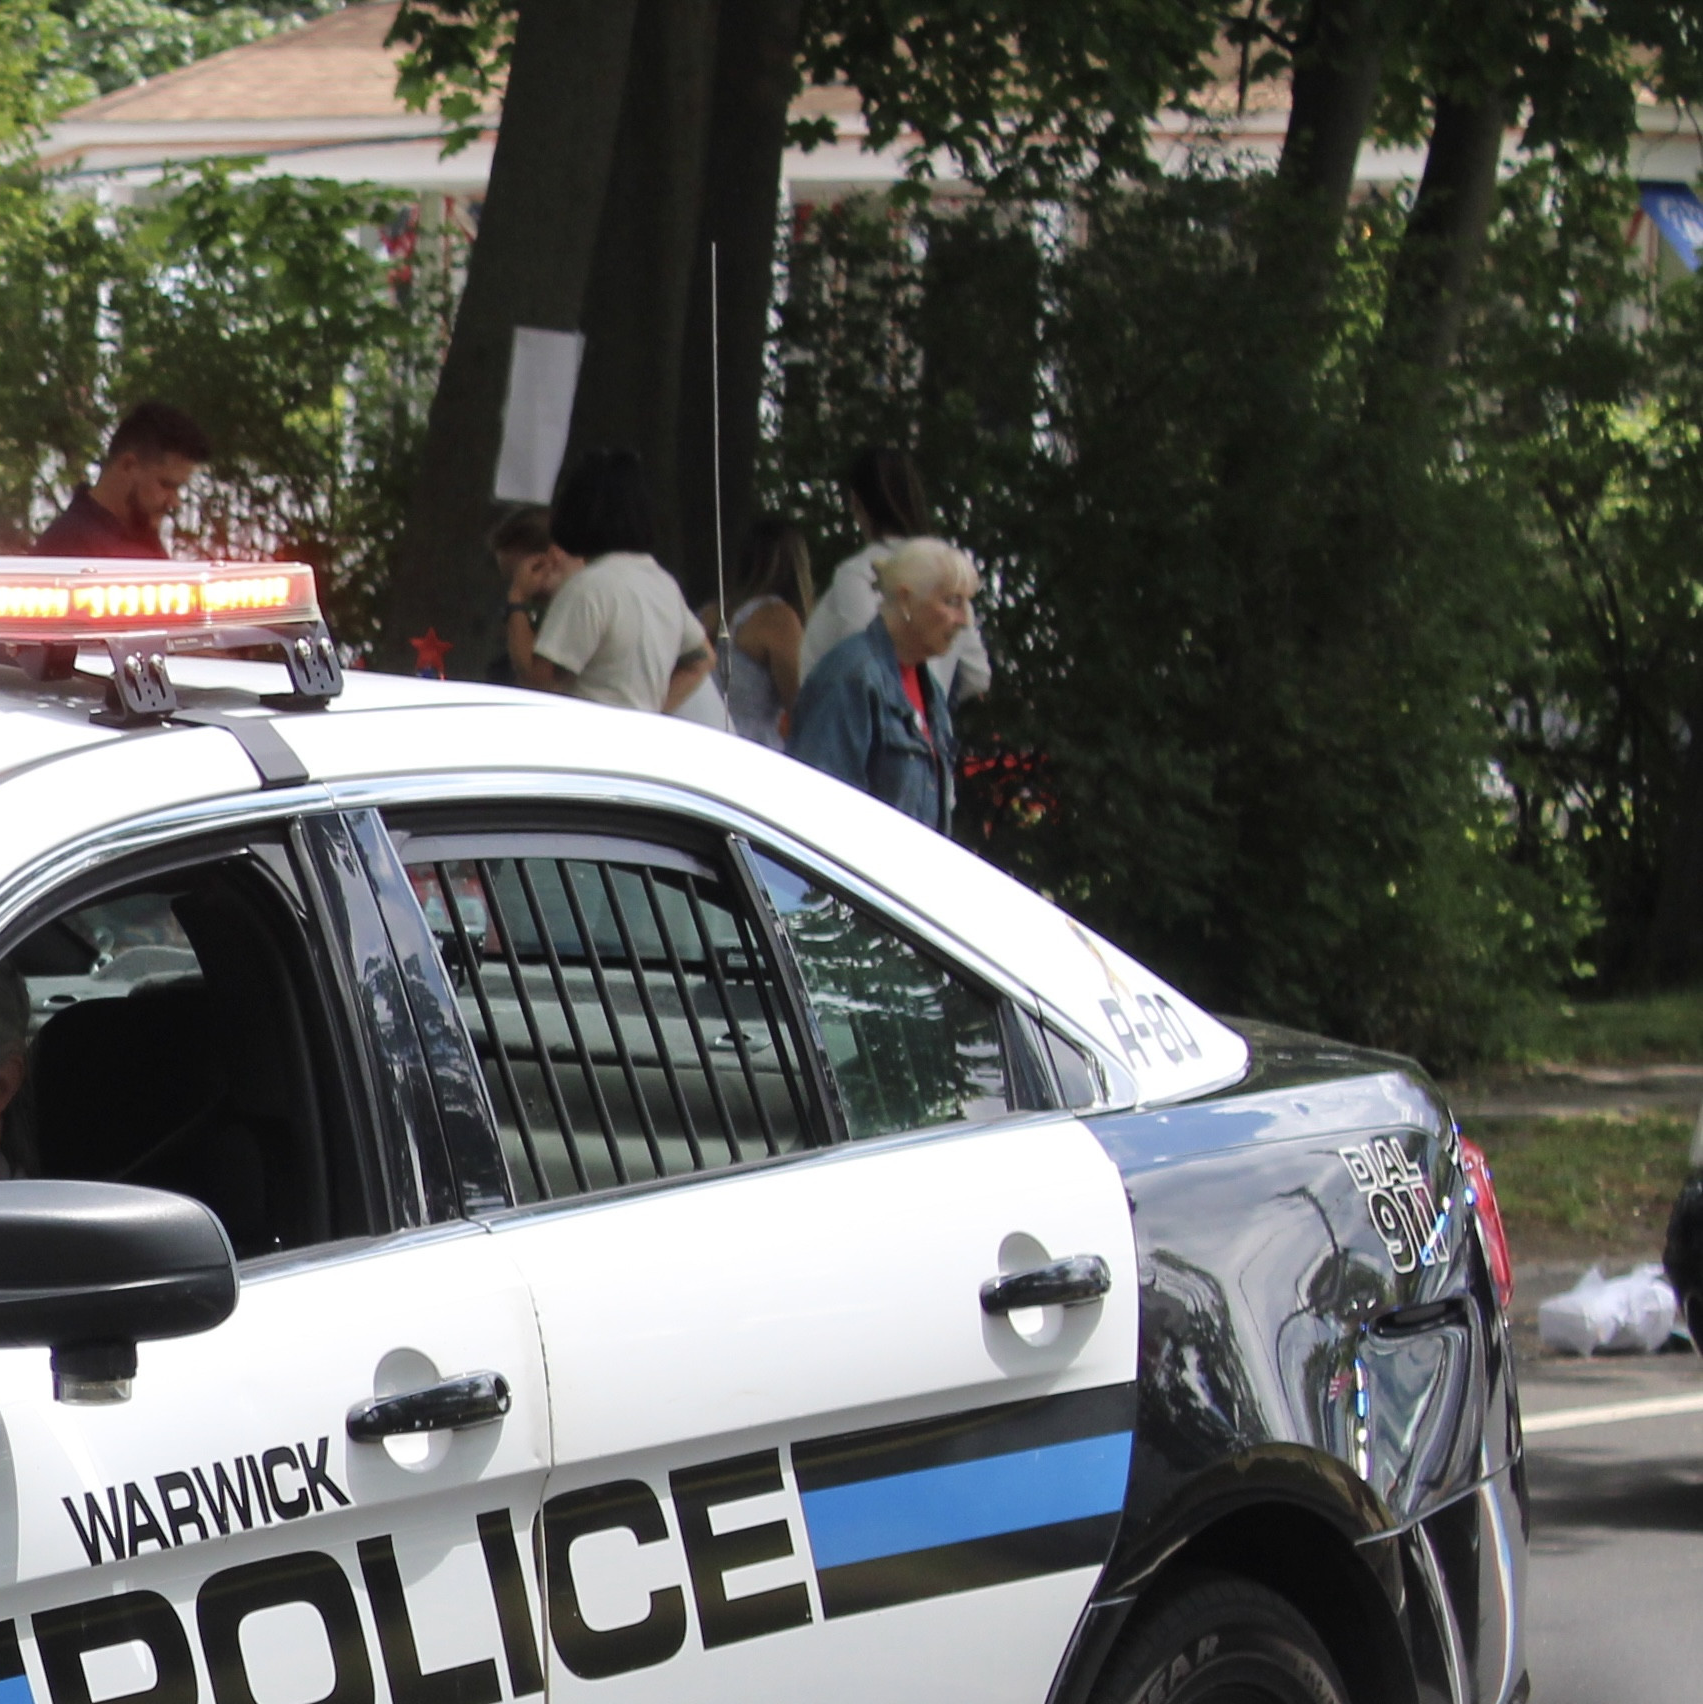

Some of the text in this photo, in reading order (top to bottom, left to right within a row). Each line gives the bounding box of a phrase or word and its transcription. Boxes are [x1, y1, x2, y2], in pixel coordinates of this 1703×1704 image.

[1098, 993, 1203, 1071] R-80
[1339, 1136, 1422, 1192] DIAL
[1368, 1183, 1450, 1274] 911
[61, 1437, 352, 1567] WARWICK
